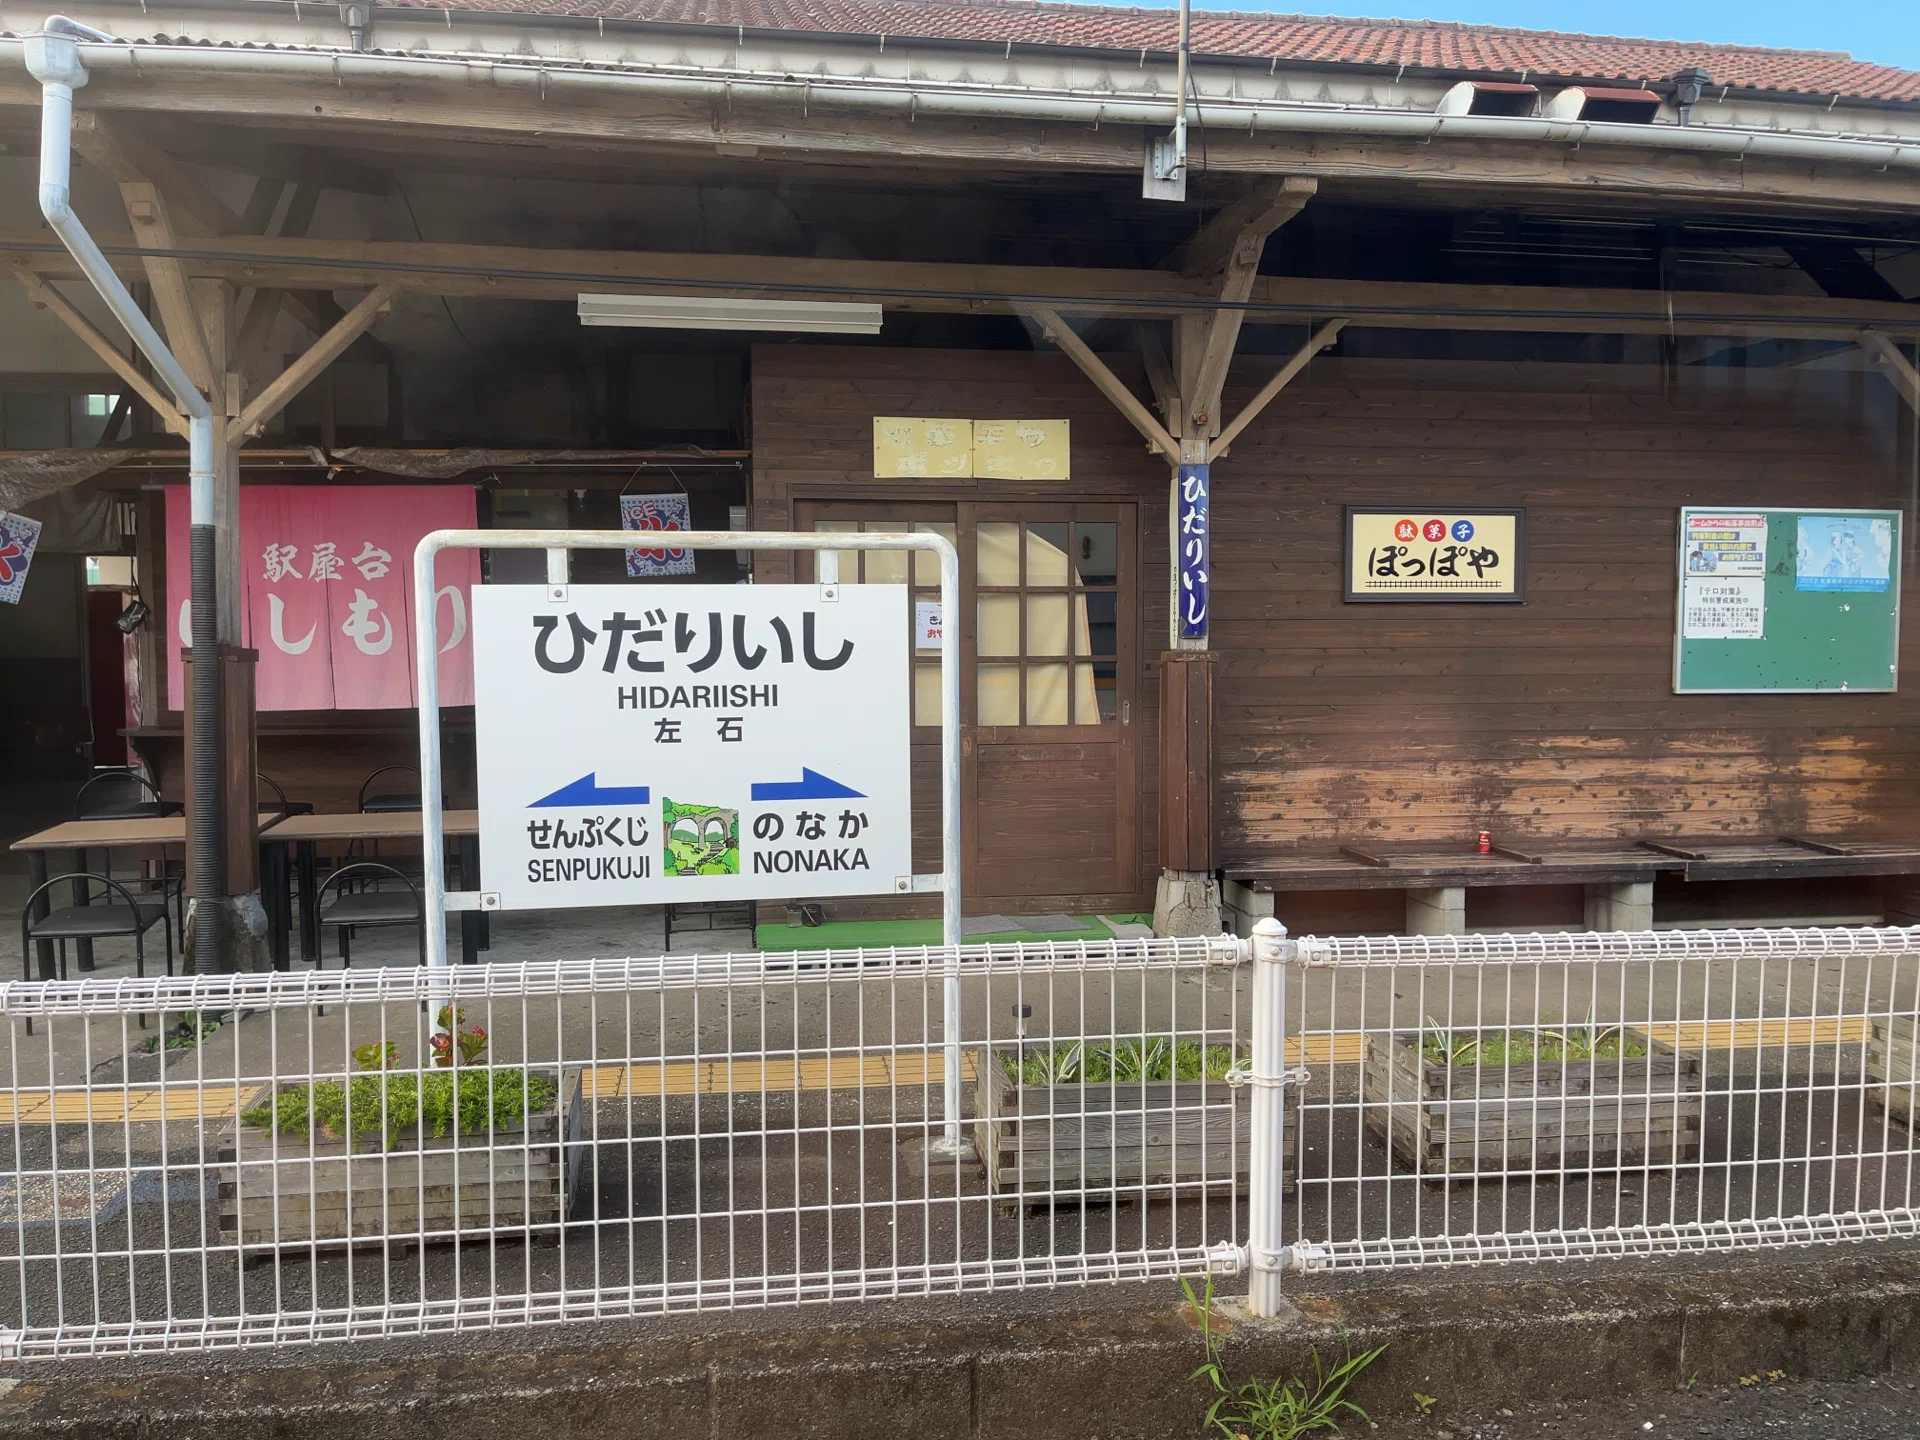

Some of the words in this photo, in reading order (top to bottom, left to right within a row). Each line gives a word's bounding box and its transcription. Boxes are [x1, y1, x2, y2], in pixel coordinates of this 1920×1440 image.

[623, 500, 657, 522] ICE
[1398, 523, 1471, 540] 駄菓子
[262, 541, 392, 583] 駅屋台
[1182, 475, 1208, 625] ひだりいし
[1368, 545, 1500, 579] ぽっぽや
[532, 608, 855, 674] ひだりいし
[617, 684, 778, 710] HIDARIISHI
[527, 815, 649, 850] せんぷくじ
[753, 810, 869, 841] のなか
[527, 855, 651, 884] SENPUKUJI
[753, 848, 870, 874] NONAKA
